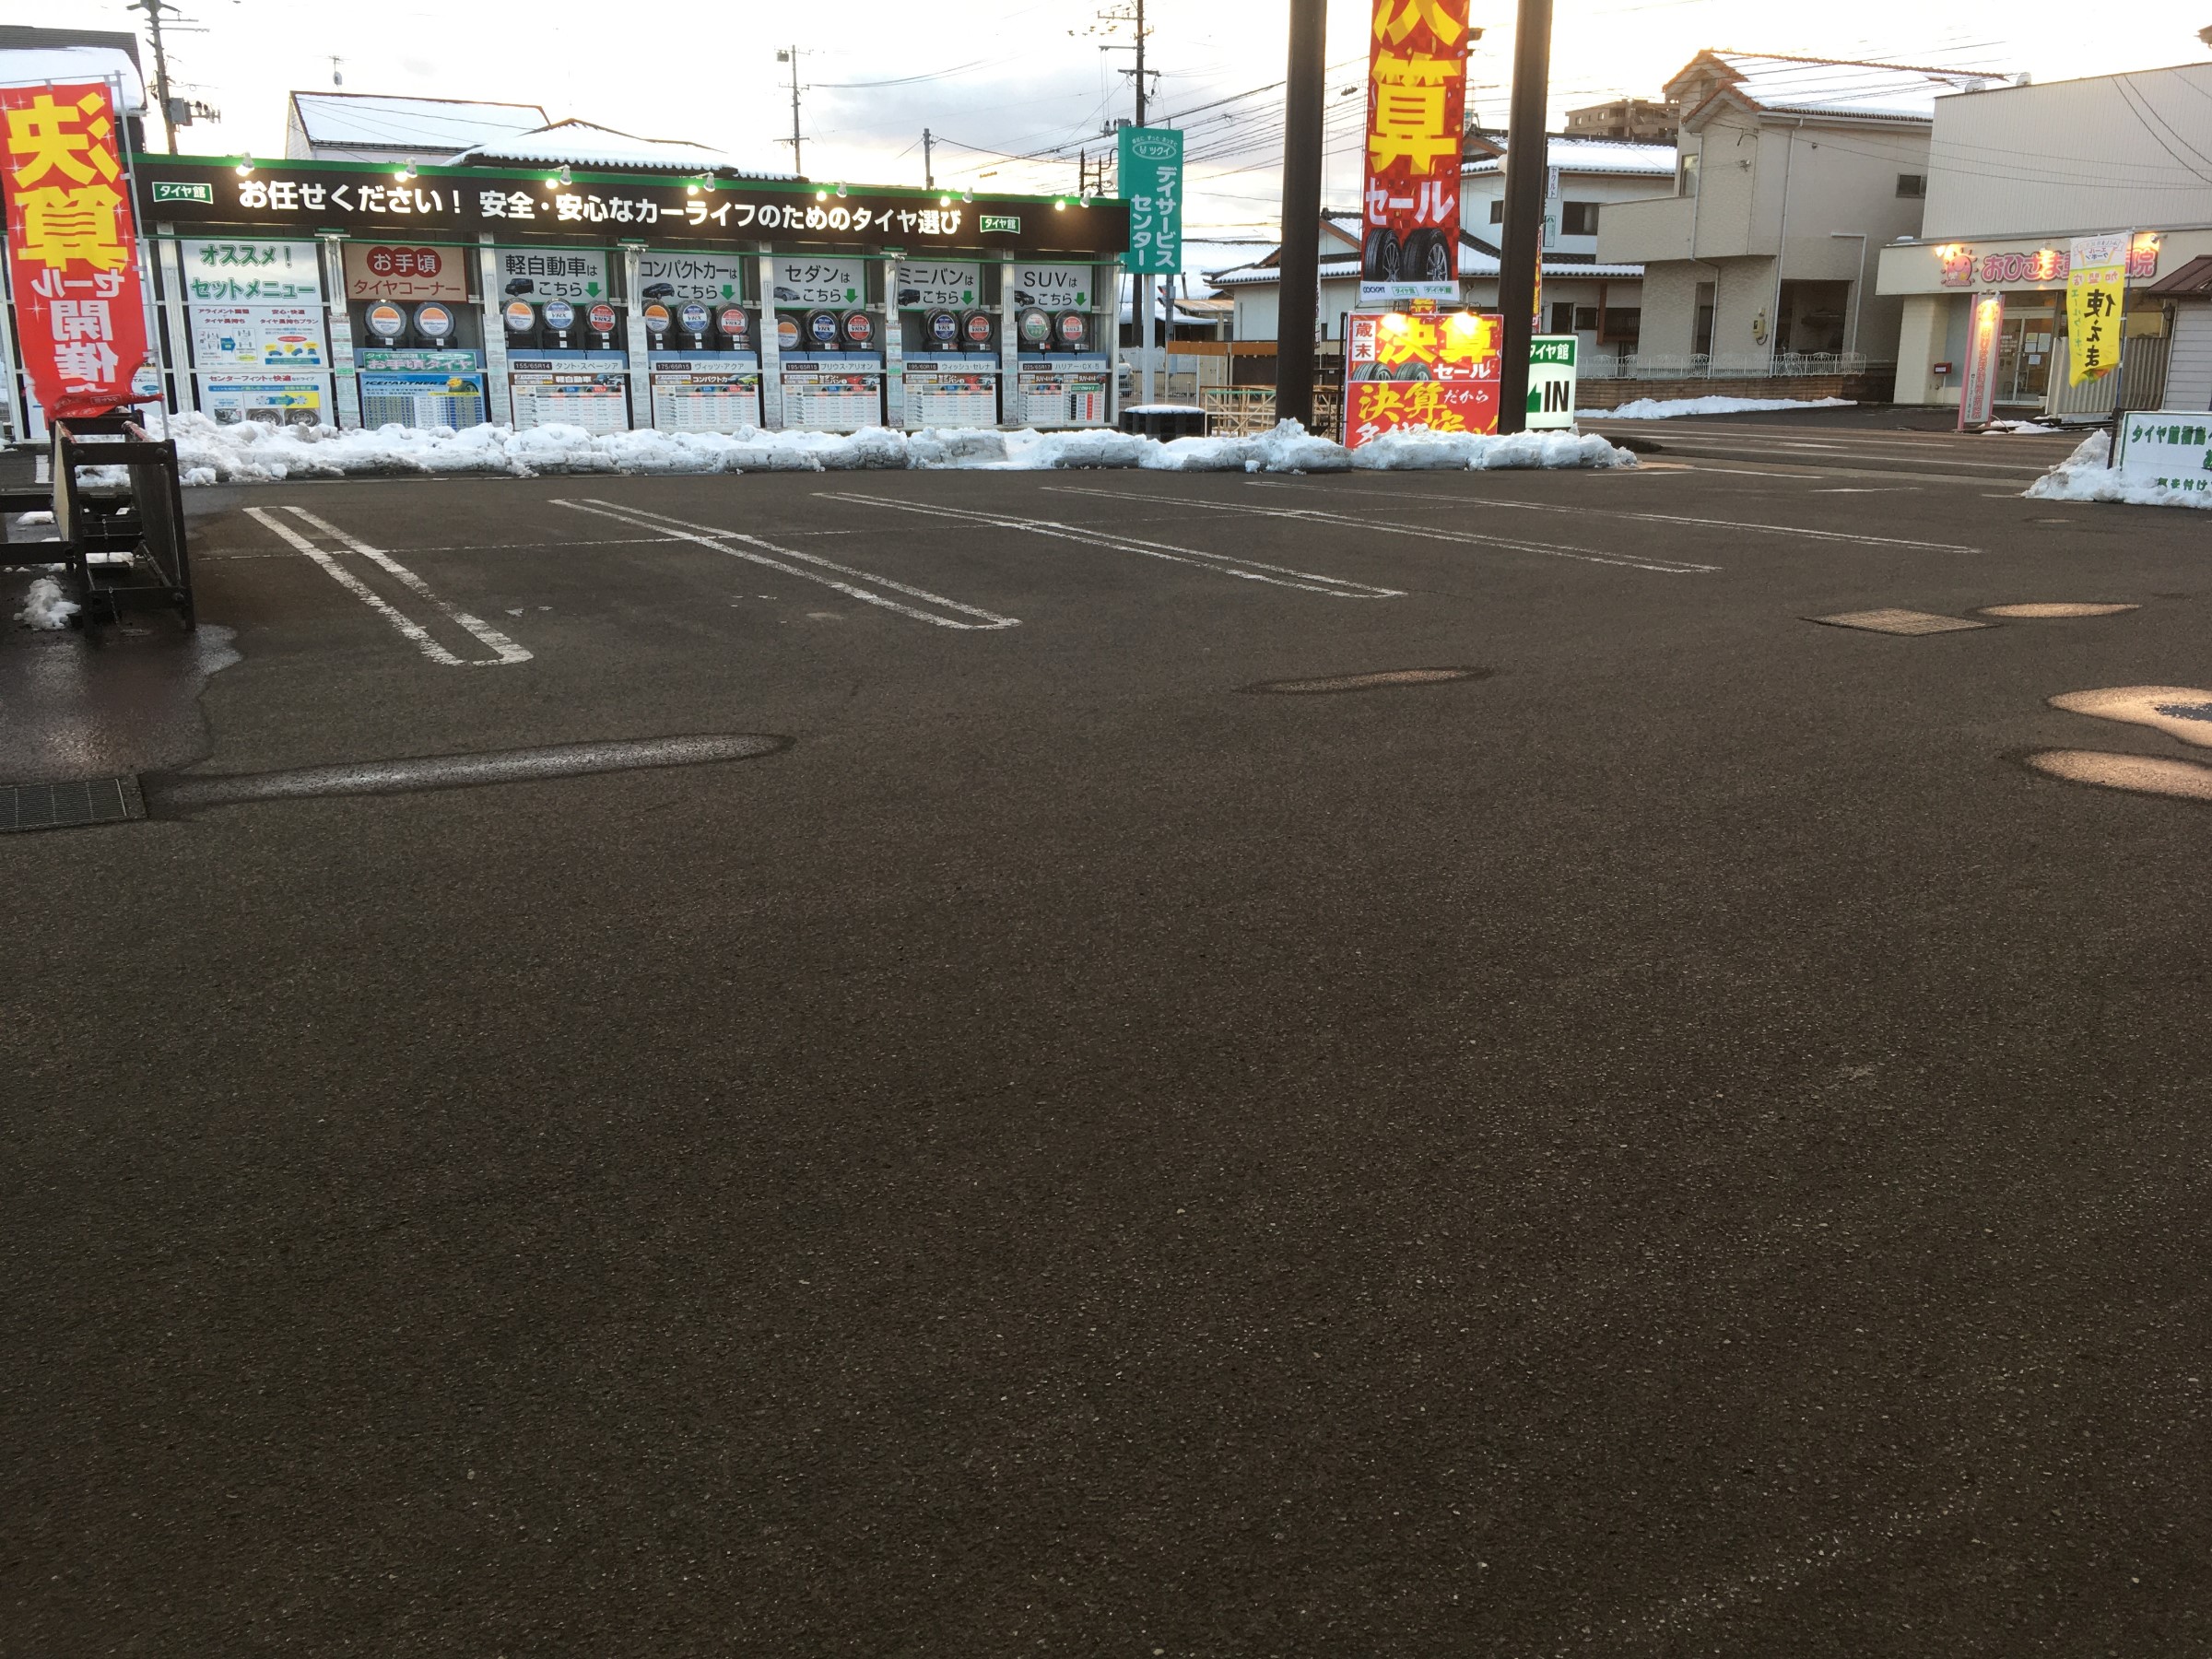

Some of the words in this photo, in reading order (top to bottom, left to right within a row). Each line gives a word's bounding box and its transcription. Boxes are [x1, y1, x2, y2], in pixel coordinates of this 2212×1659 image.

[1149, 147, 1171, 156] ツクイ
[159, 185, 206, 198] タイヤ館
[238, 181, 461, 214] お任せください！
[479, 190, 961, 235] 安全・安心なカーライフのためのタイヤ選び
[1366, 176, 1455, 226] セール
[983, 218, 1018, 231] タイヤ館
[1155, 166, 1177, 267] デイサービス
[1131, 194, 1152, 266] センター
[200, 244, 291, 268] オススメ！
[373, 253, 437, 274] お手頃
[505, 254, 598, 276] 軽自動車は
[641, 259, 737, 279] コンパクトカーは
[785, 265, 851, 283] セダンは
[899, 267, 973, 286] ミニバンは
[190, 277, 315, 300] セットメニュー
[354, 279, 461, 296] タイヤコーナー
[1024, 271, 1077, 288] SUVは
[538, 281, 582, 297] こちら
[677, 285, 718, 300] こちら
[803, 288, 841, 302] こちら
[923, 290, 959, 304] こちら
[1039, 293, 1072, 306] こちら
[1355, 323, 1372, 359] 歳末
[1377, 315, 1497, 364] 決算
[1433, 363, 1490, 379] セール
[1544, 381, 1570, 413] IN
[2158, 477, 2212, 491] 気を付け
